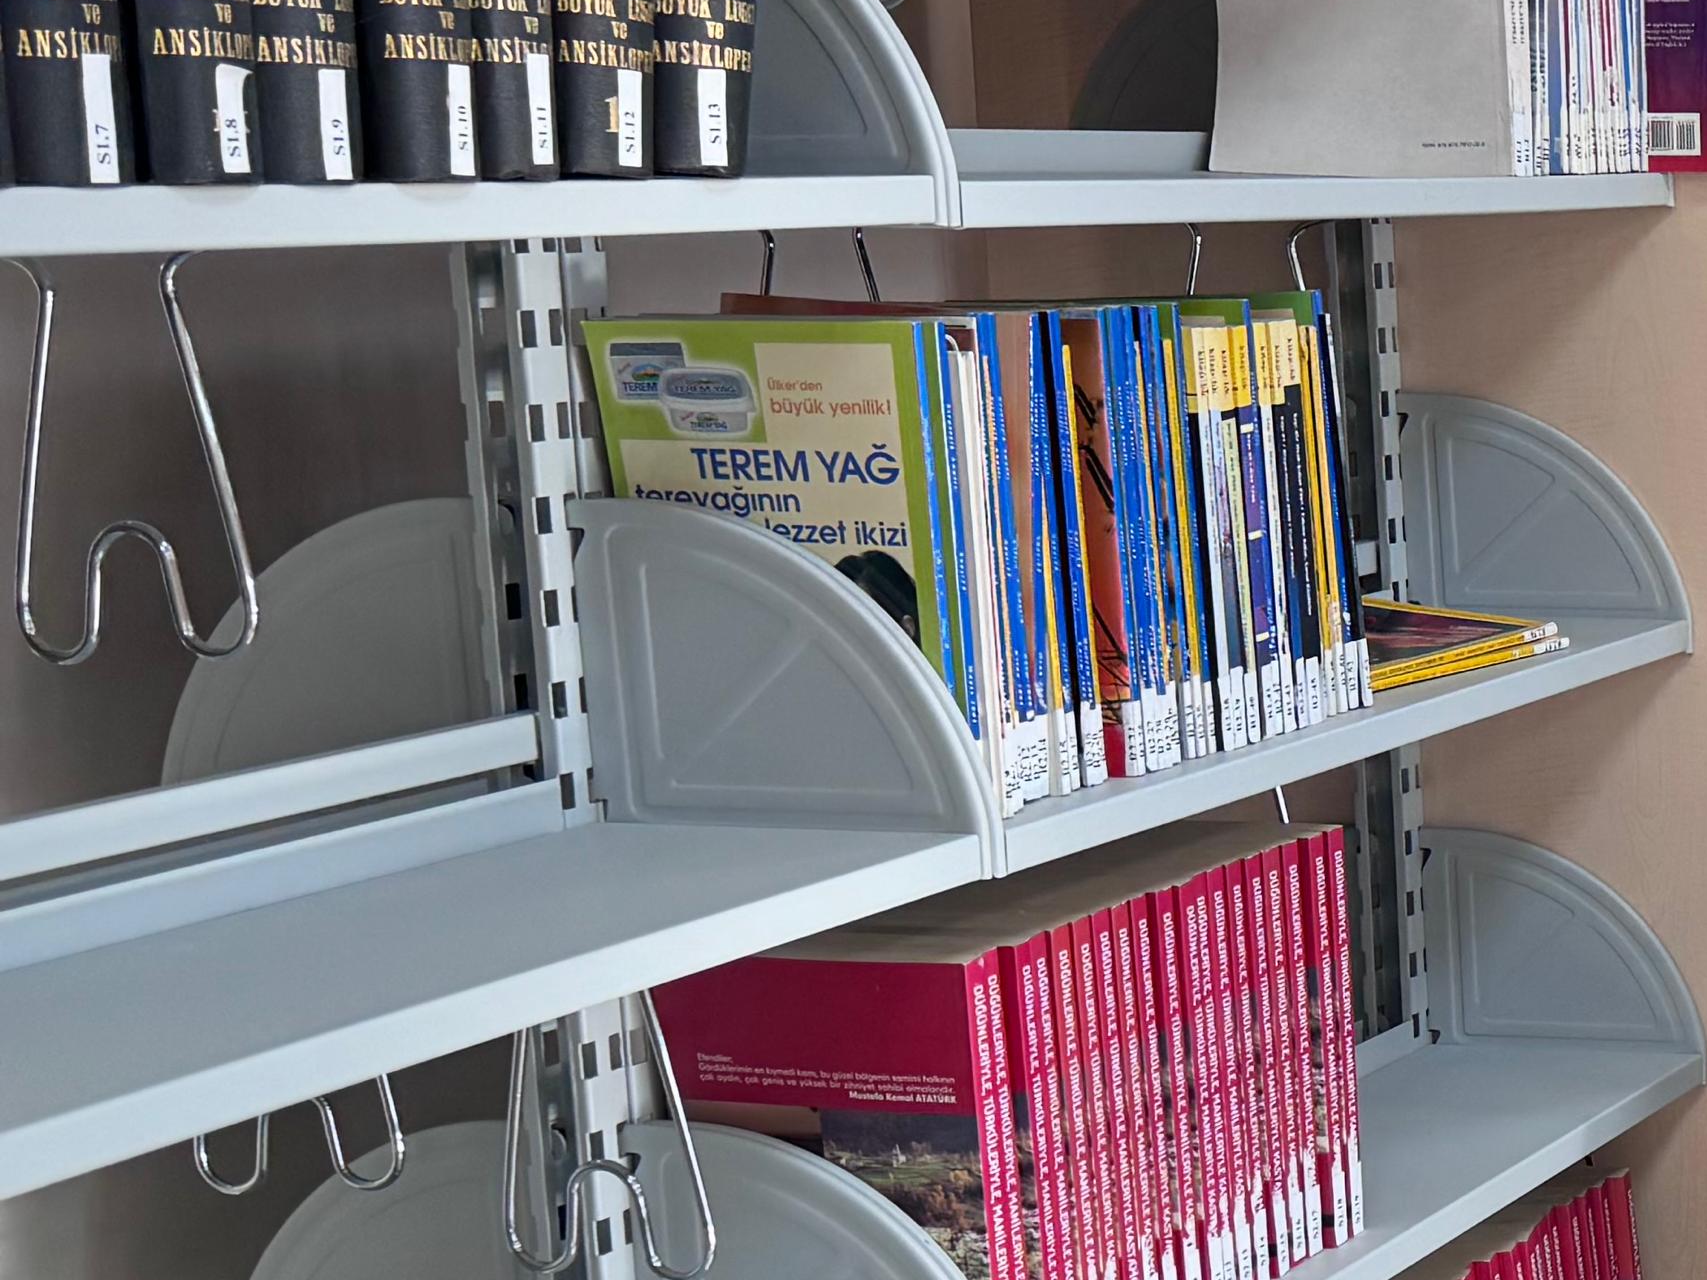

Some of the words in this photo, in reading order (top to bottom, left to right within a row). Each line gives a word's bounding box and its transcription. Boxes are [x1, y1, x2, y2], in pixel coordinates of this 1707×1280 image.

[80, 4, 101, 25] ve
[214, 4, 232, 24] ve
[316, 12, 335, 33] ve
[438, 11, 455, 30] ve
[523, 16, 539, 35] ve
[611, 21, 628, 40] ve
[705, 21, 724, 40] ve
[624, 111, 636, 154] S1.12
[707, 102, 721, 145] S1.13
[95, 123, 111, 166] S1.7
[225, 118, 241, 158] S1.8
[331, 118, 346, 157] S1.9
[767, 377, 823, 392] Ülker'den
[770, 398, 824, 417] büyük
[830, 398, 891, 418] yenilik!
[690, 447, 811, 483] TEREM
[815, 443, 900, 485] YAĞ
[854, 521, 908, 547] ikizi
